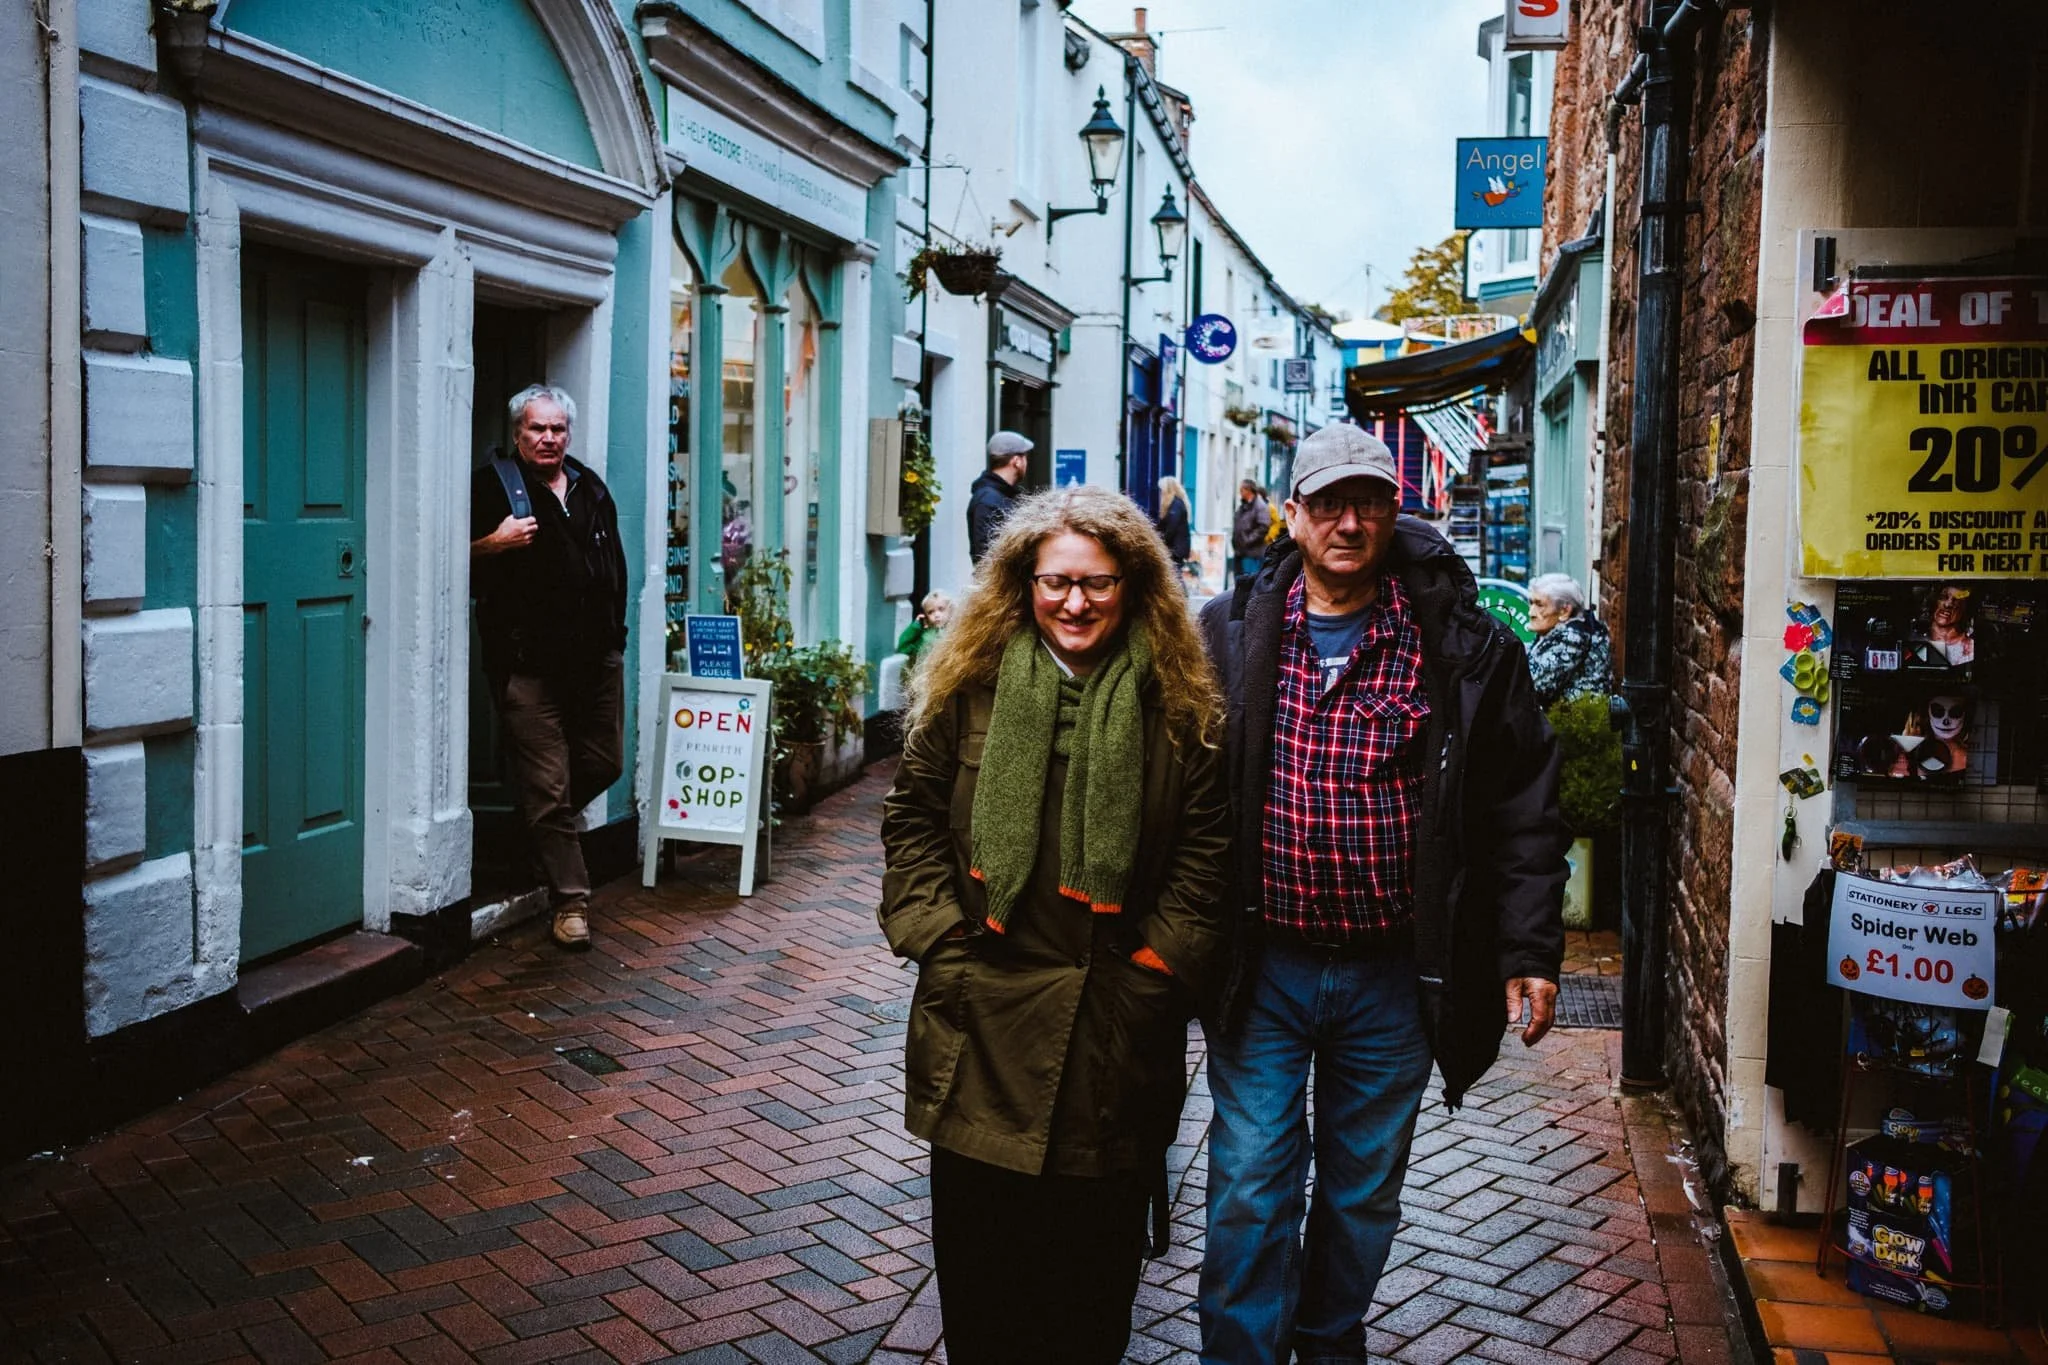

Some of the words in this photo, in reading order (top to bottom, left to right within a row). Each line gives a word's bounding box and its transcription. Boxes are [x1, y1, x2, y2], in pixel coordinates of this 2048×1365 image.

[708, 129, 741, 165] RESTORE
[1466, 144, 1541, 176] Angel
[1840, 291, 1941, 328] DEAL
[1959, 291, 2013, 326] OF
[1867, 350, 1926, 381] ALL
[1919, 382, 1977, 415] INK
[1929, 511, 2026, 530] DISCOUNT
[1865, 532, 1941, 551] ORDERS
[1948, 531, 2022, 550] PLACED
[1938, 554, 1975, 573] FOR
[1982, 553, 2032, 572] NEXT
[699, 660, 732, 668] PLEASE
[700, 667, 733, 677] QUEUE
[674, 708, 751, 734] OPEN
[685, 742, 743, 756] PENRITH
[681, 785, 743, 809] SHOP
[1848, 890, 1918, 911] STATIONERY
[1945, 905, 1983, 916] LESS
[1851, 912, 1918, 941] Spider
[1924, 925, 1978, 946] Web
[1866, 948, 1954, 984] £1.00
[1874, 1241, 1921, 1269] DARK
